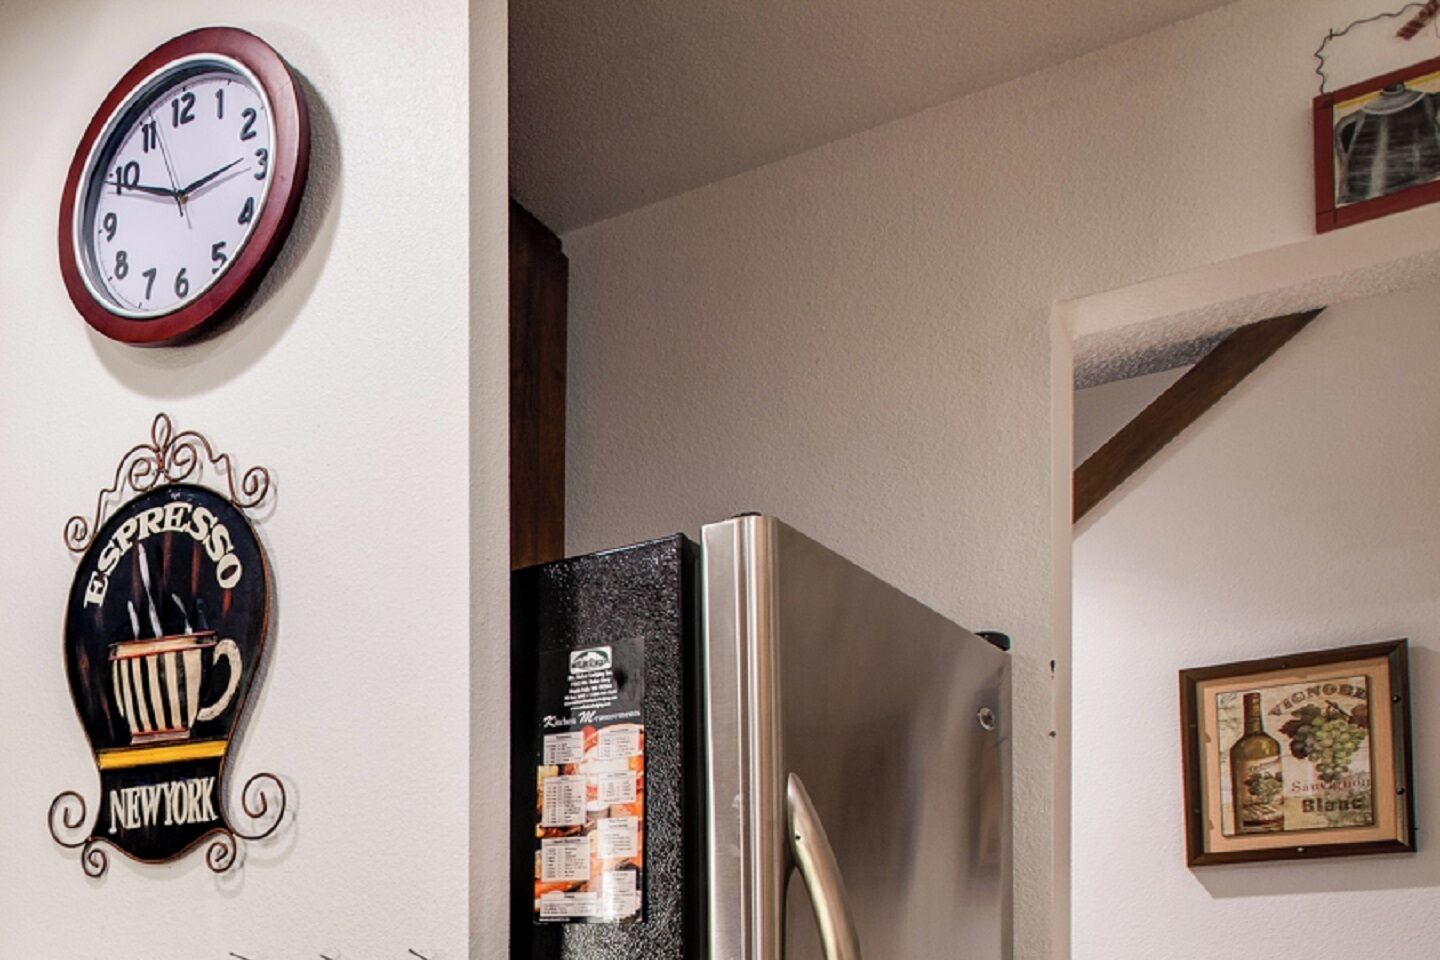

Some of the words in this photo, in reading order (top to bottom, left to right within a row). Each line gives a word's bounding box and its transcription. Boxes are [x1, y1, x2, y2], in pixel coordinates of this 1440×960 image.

[171, 92, 196, 128] 12
[215, 89, 224, 119] 1
[141, 120, 156, 154] 11
[240, 107, 257, 141] 2
[115, 161, 140, 196] 10
[254, 147, 268, 181] 3
[102, 212, 117, 242] 9
[238, 197, 255, 226] 4
[115, 250, 129, 280] 8
[211, 241, 227, 275] 5
[141, 268, 157, 301] 7
[174, 267, 189, 298] 6
[83, 501, 243, 608] ESPRESSO
[108, 783, 161, 834] NEW
[157, 776, 219, 826] YORK
[1302, 798, 1363, 813] Blanc
